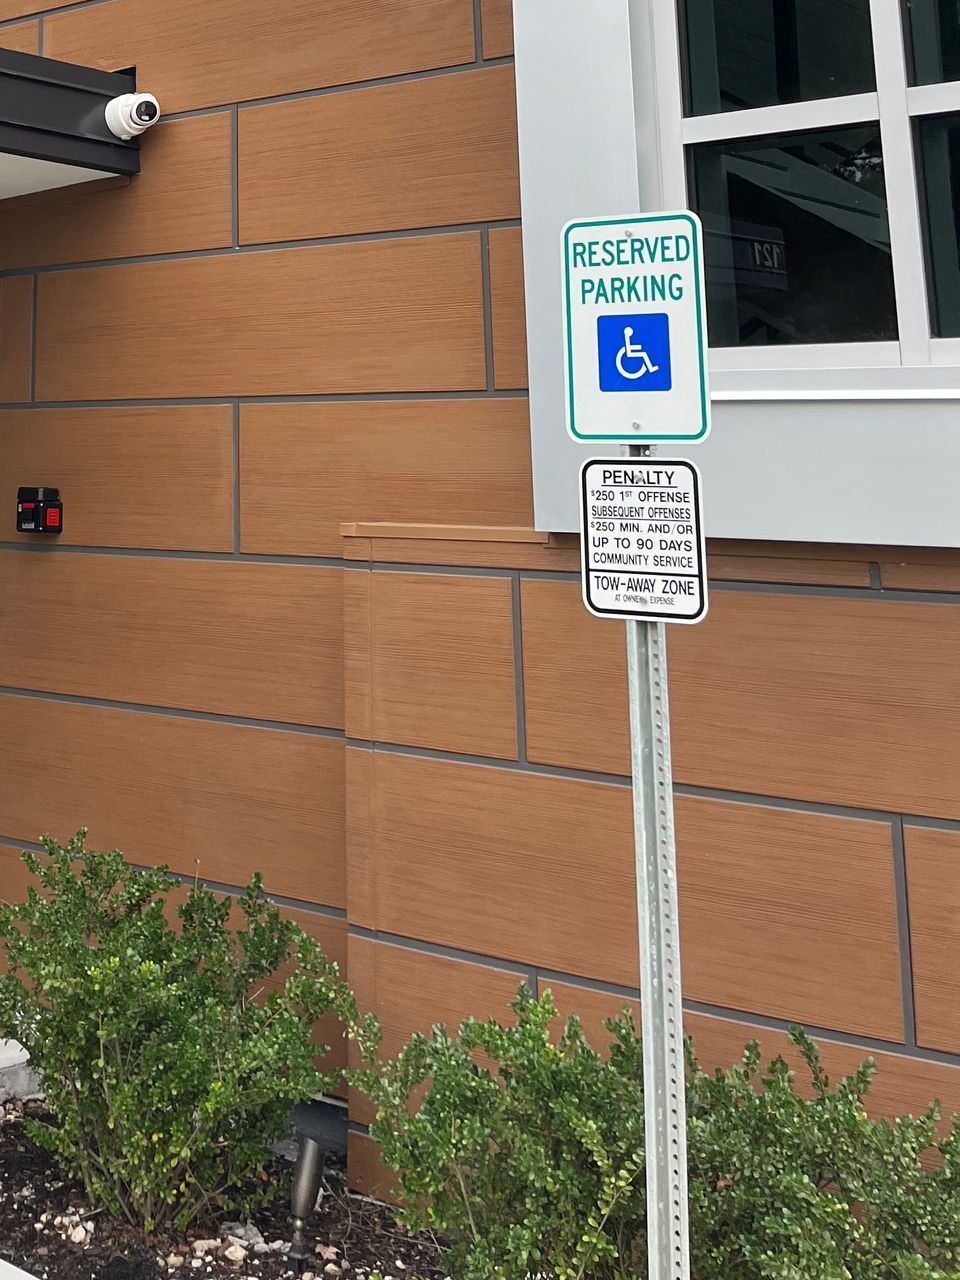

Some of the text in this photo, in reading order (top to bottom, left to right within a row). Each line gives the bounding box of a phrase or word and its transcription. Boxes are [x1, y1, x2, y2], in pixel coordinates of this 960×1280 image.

[573, 235, 690, 268] RESERVED
[581, 273, 683, 304] PARKING
[603, 470, 675, 484] PENALTY
[591, 490, 615, 501] $250
[638, 491, 690, 503] OFFENSE
[591, 505, 691, 519] SUBSEQUENT OFFENSES
[591, 521, 693, 535] $250 MIN. AND/OR
[592, 536, 693, 552] UP TO 90 DAYS
[593, 552, 693, 568] COMMUNITY SERVICE
[594, 575, 695, 596] TOW-AWAY ZONE
[649, 596, 674, 606] EXPENSE
